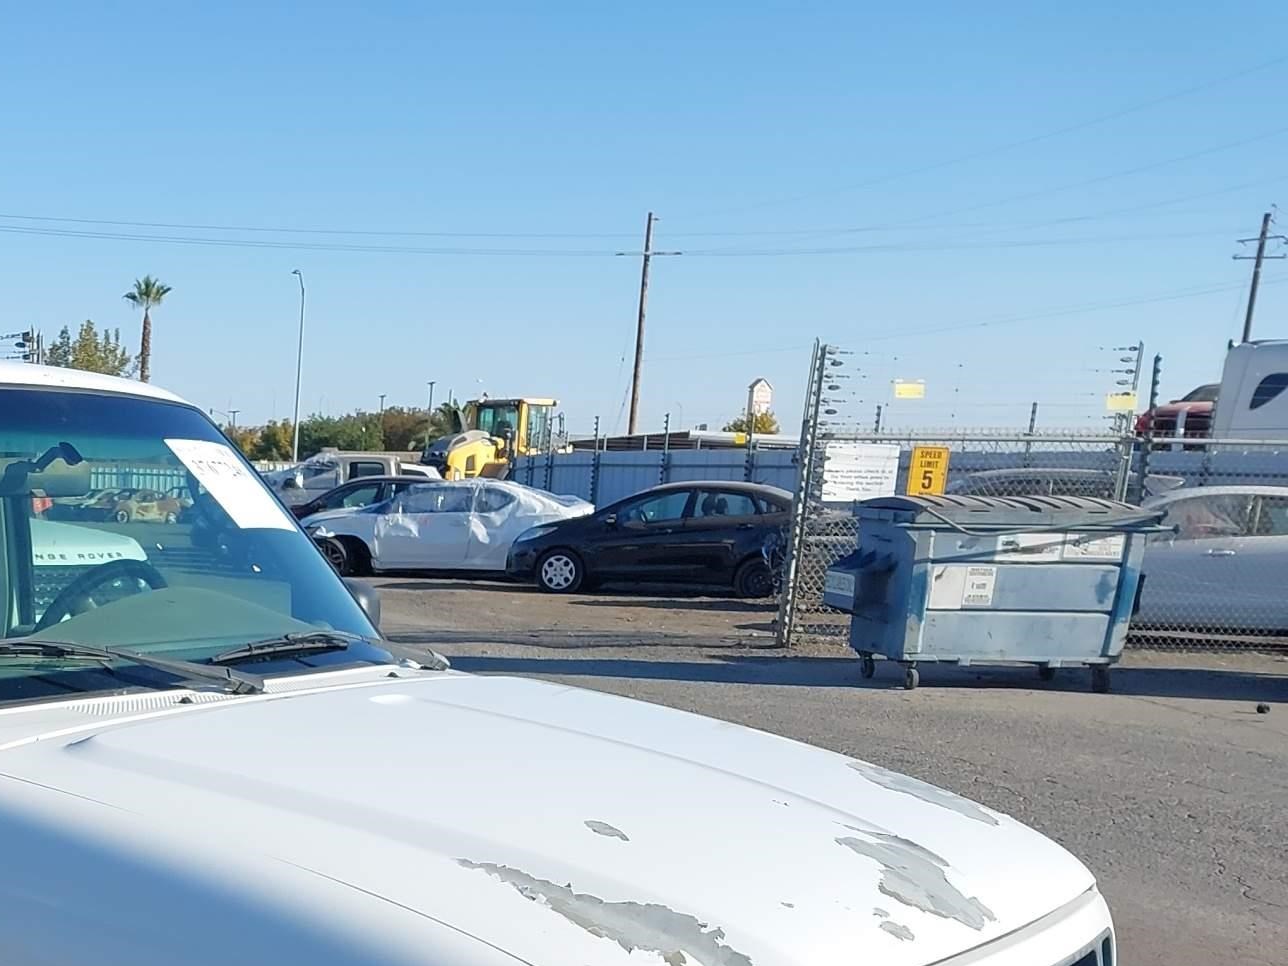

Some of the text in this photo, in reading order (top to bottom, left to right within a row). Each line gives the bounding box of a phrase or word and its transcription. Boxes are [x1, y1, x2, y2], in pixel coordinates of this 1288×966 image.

[920, 451, 942, 459] SPEED
[920, 460, 939, 469] LIMIT
[921, 470, 934, 490] 5
[77, 551, 124, 560] ROVER
